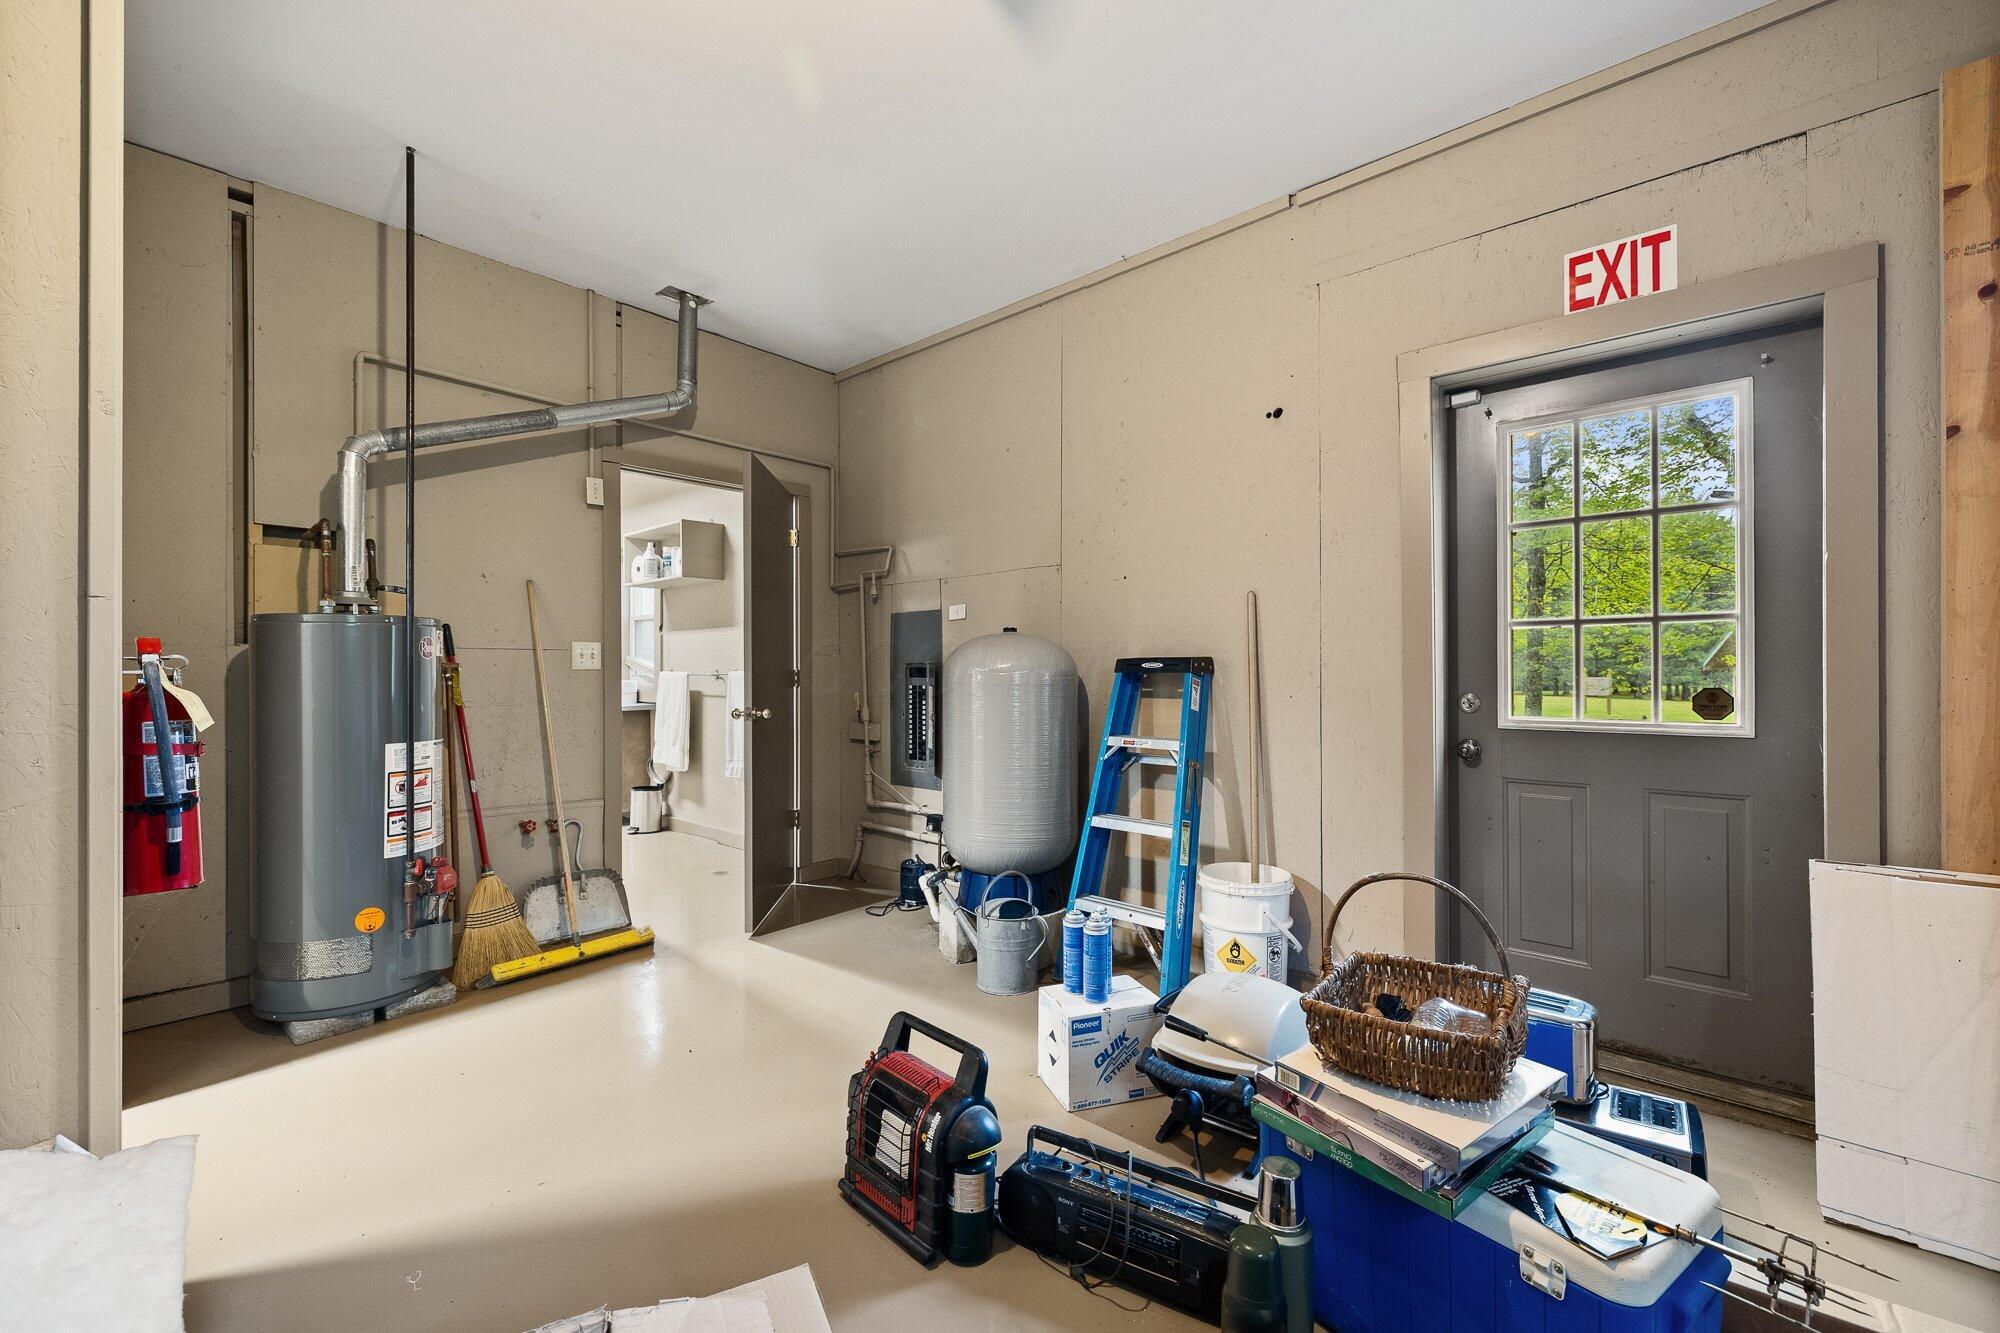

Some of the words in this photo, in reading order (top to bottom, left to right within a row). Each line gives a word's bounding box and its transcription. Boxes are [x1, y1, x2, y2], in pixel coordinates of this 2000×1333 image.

[1569, 230, 1671, 312] EXIT
[1072, 1020, 1100, 1030] Pioneer
[1094, 1029, 1130, 1069] QUIK
[1104, 1047, 1140, 1084] STRIPE
[927, 1111, 942, 1140] Heater
[1057, 1196, 1075, 1207] SONY
